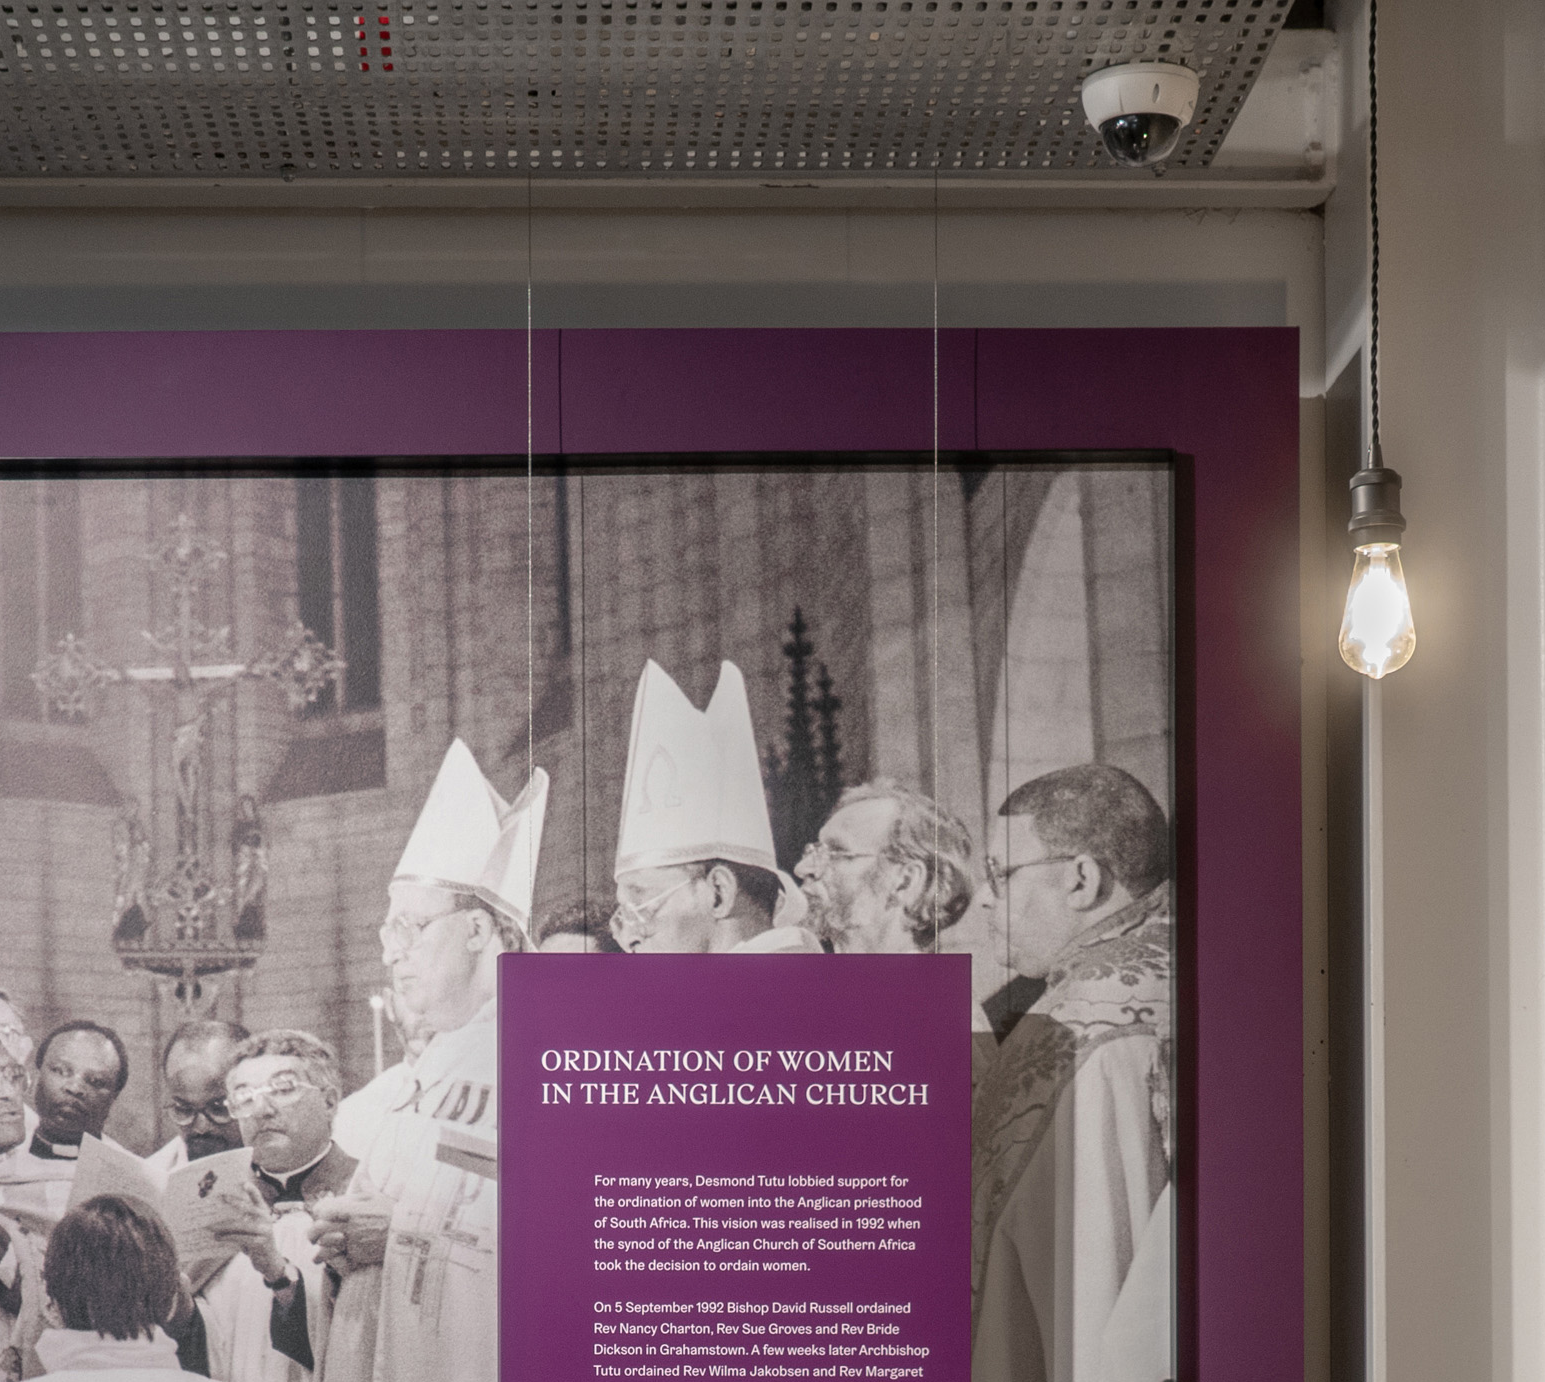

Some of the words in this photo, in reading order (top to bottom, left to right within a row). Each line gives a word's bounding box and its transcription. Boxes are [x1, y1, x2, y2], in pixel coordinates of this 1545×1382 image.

[541, 1049, 725, 1072] ORDINATION
[733, 1050, 772, 1072] OF
[776, 1050, 894, 1072] WOMEN
[542, 1083, 573, 1104] IN
[580, 1083, 639, 1105] THE
[646, 1083, 797, 1105] ANGLICAN
[806, 1083, 929, 1105] CHURCH
[594, 1174, 616, 1186] For
[618, 1177, 652, 1189] many
[654, 1177, 693, 1189] years,
[695, 1175, 755, 1187] Desmond
[757, 1175, 785, 1187] Tutu
[788, 1175, 834, 1187] lobbied
[837, 1176, 887, 1190] support
[890, 1174, 909, 1187] for
[594, 1216, 608, 1229] of
[610, 1217, 647, 1229] South
[649, 1216, 690, 1229] Africa.
[692, 1217, 719, 1229] This
[721, 1217, 758, 1229] vision
[760, 1220, 786, 1229] was
[788, 1217, 839, 1229] realised
[841, 1218, 853, 1229] in
[856, 1217, 885, 1229] 1992
[887, 1217, 921, 1230] when
[594, 1259, 622, 1271] took
[624, 1259, 645, 1271] the
[648, 1259, 700, 1271] decision
[703, 1260, 717, 1271] to
[719, 1259, 760, 1271] ordain
[762, 1262, 811, 1271] women.
[593, 1301, 612, 1313] On
[615, 1301, 623, 1313] 5
[625, 1301, 694, 1316] September
[696, 1301, 724, 1313] 1992
[727, 1301, 769, 1316] Bishop
[772, 1301, 807, 1314] David
[809, 1301, 853, 1314] Russell
[856, 1302, 911, 1314] ordained
[594, 1322, 617, 1334] Rev
[619, 1322, 658, 1337] Nancy
[660, 1322, 714, 1336] Charton,
[716, 1323, 740, 1334] Rev
[742, 1323, 766, 1335] Sue
[768, 1323, 813, 1335] Groves
[815, 1323, 838, 1335] and
[841, 1323, 864, 1335] Rev
[867, 1323, 900, 1335] Bride
[593, 1364, 621, 1376] Tutu
[624, 1364, 680, 1377] ordained
[683, 1365, 707, 1377] Rev
[708, 1365, 746, 1377] Wilma
[749, 1365, 810, 1377] Jakobsen
[812, 1365, 836, 1377] and
[839, 1365, 863, 1377] Rev
[865, 1365, 924, 1380] Margaret
